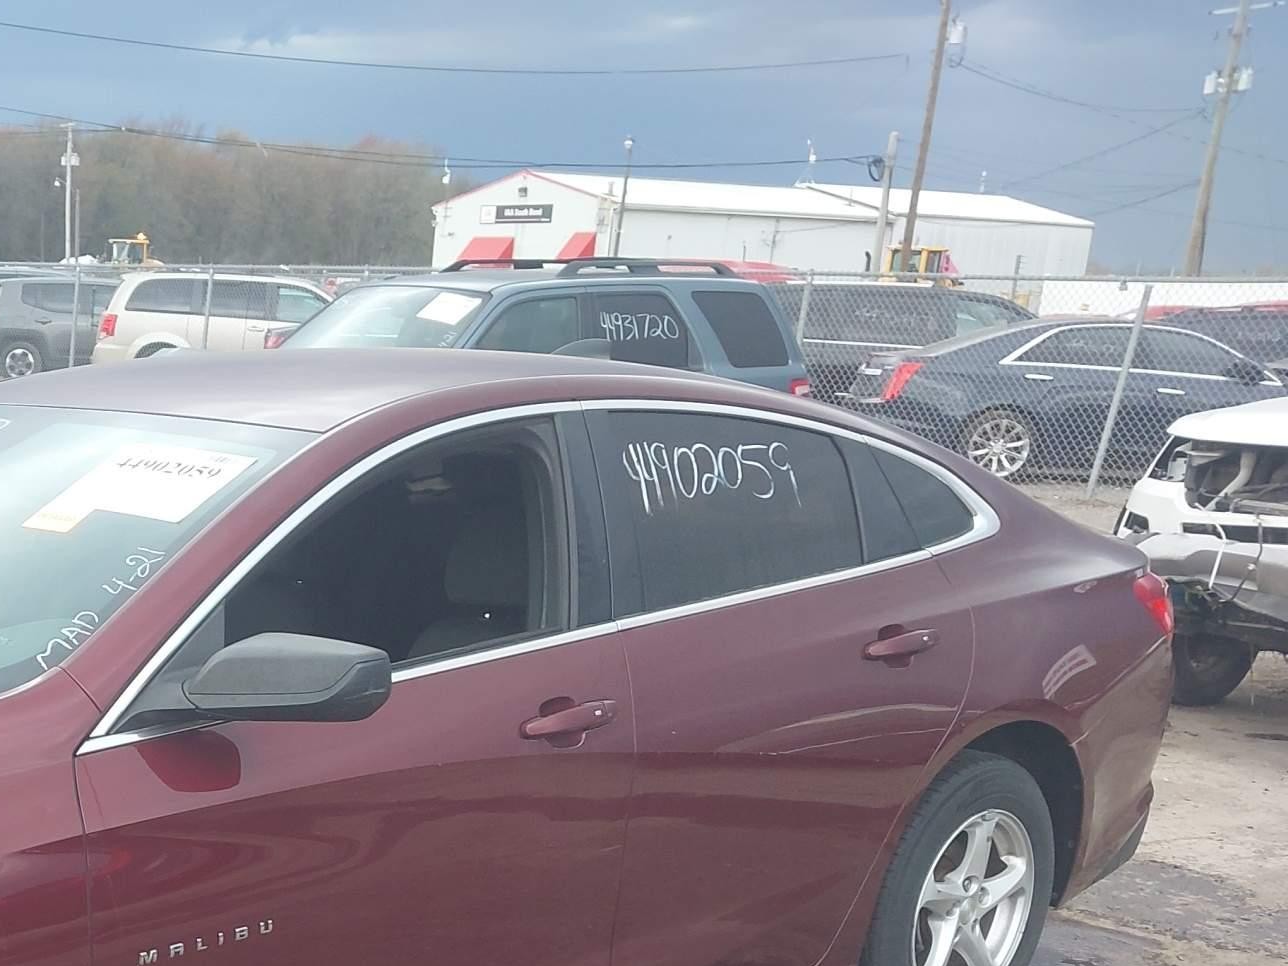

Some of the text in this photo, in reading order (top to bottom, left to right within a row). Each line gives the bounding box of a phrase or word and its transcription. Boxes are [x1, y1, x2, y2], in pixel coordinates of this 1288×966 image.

[600, 312, 679, 342] 44931720
[117, 458, 223, 479] 44902059
[622, 441, 802, 516] 44902059
[137, 920, 273, 966] MALIBU
